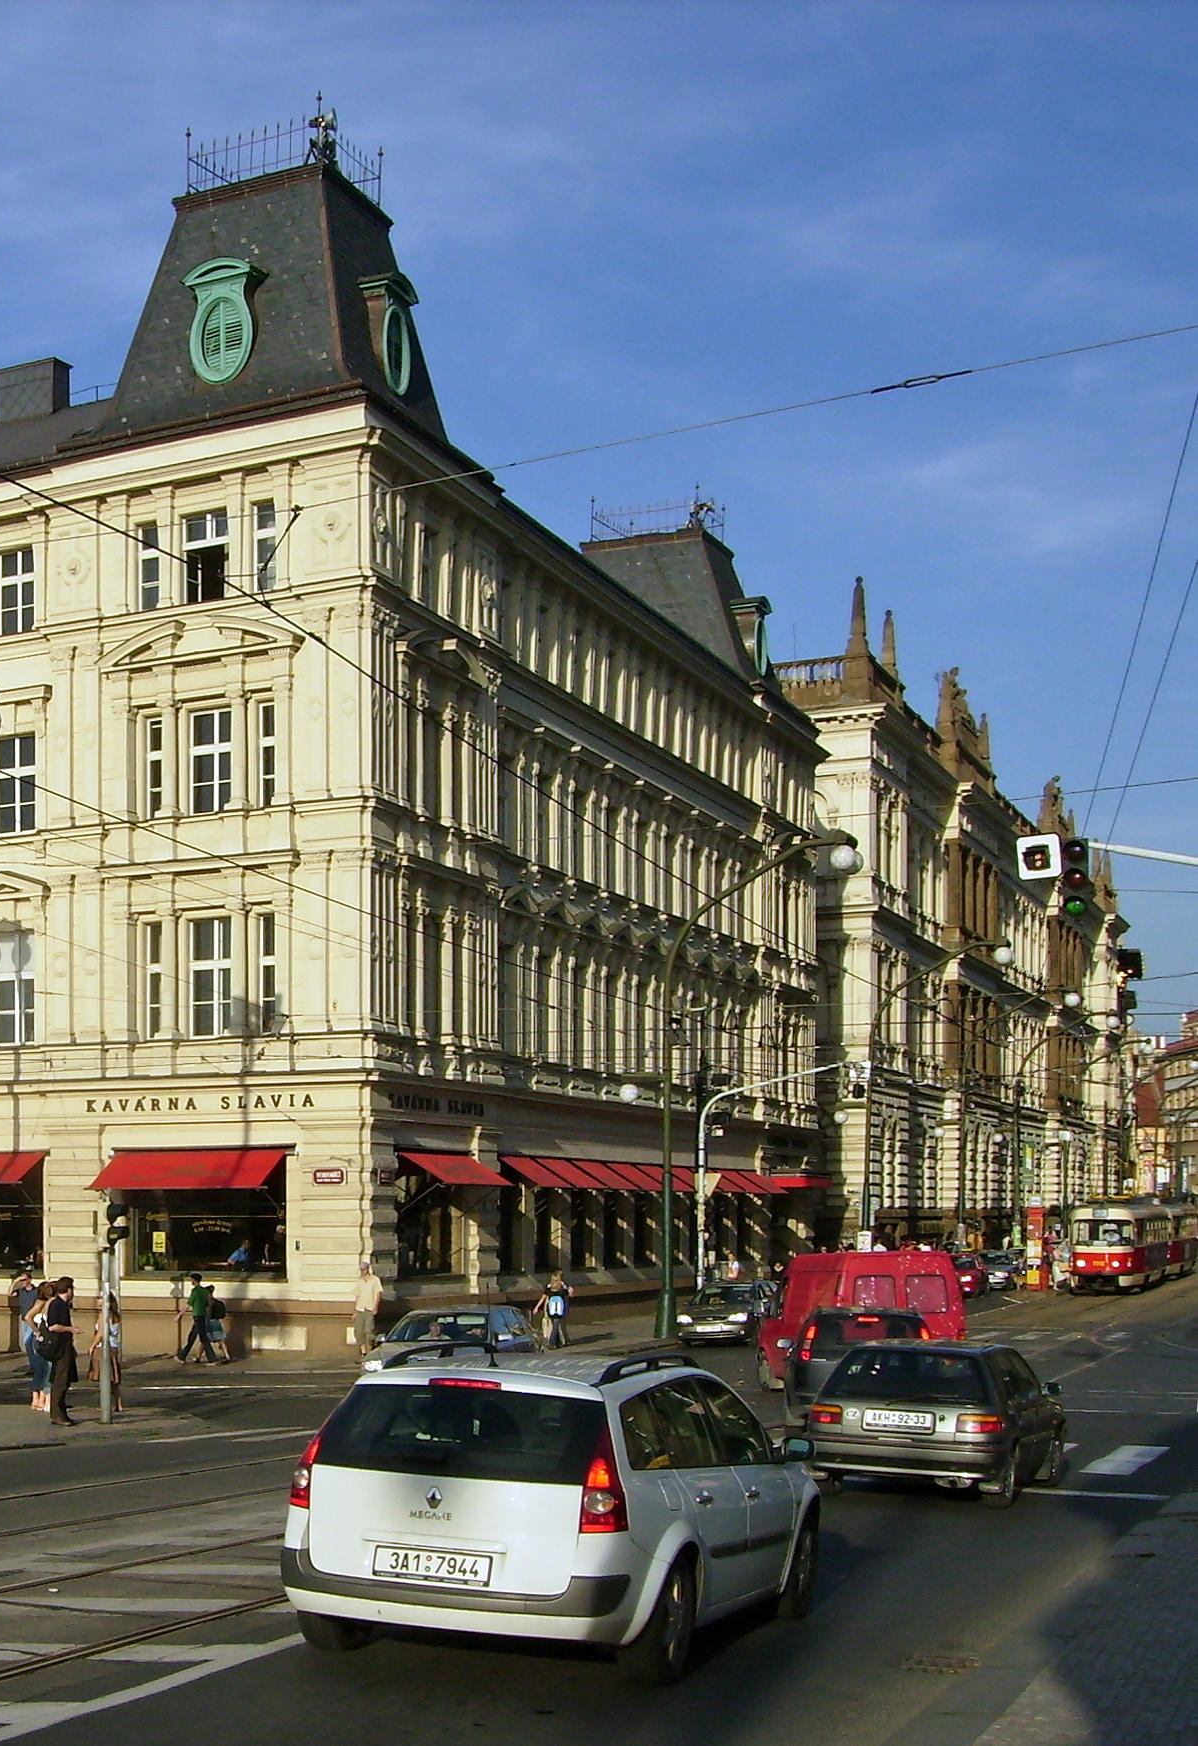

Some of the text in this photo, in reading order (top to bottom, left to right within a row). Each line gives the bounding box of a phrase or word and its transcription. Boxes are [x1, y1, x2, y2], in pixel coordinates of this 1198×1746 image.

[85, 1093, 315, 1113] KAVÁRNA SLAVIA
[389, 1551, 479, 1578] 3A1 7944
